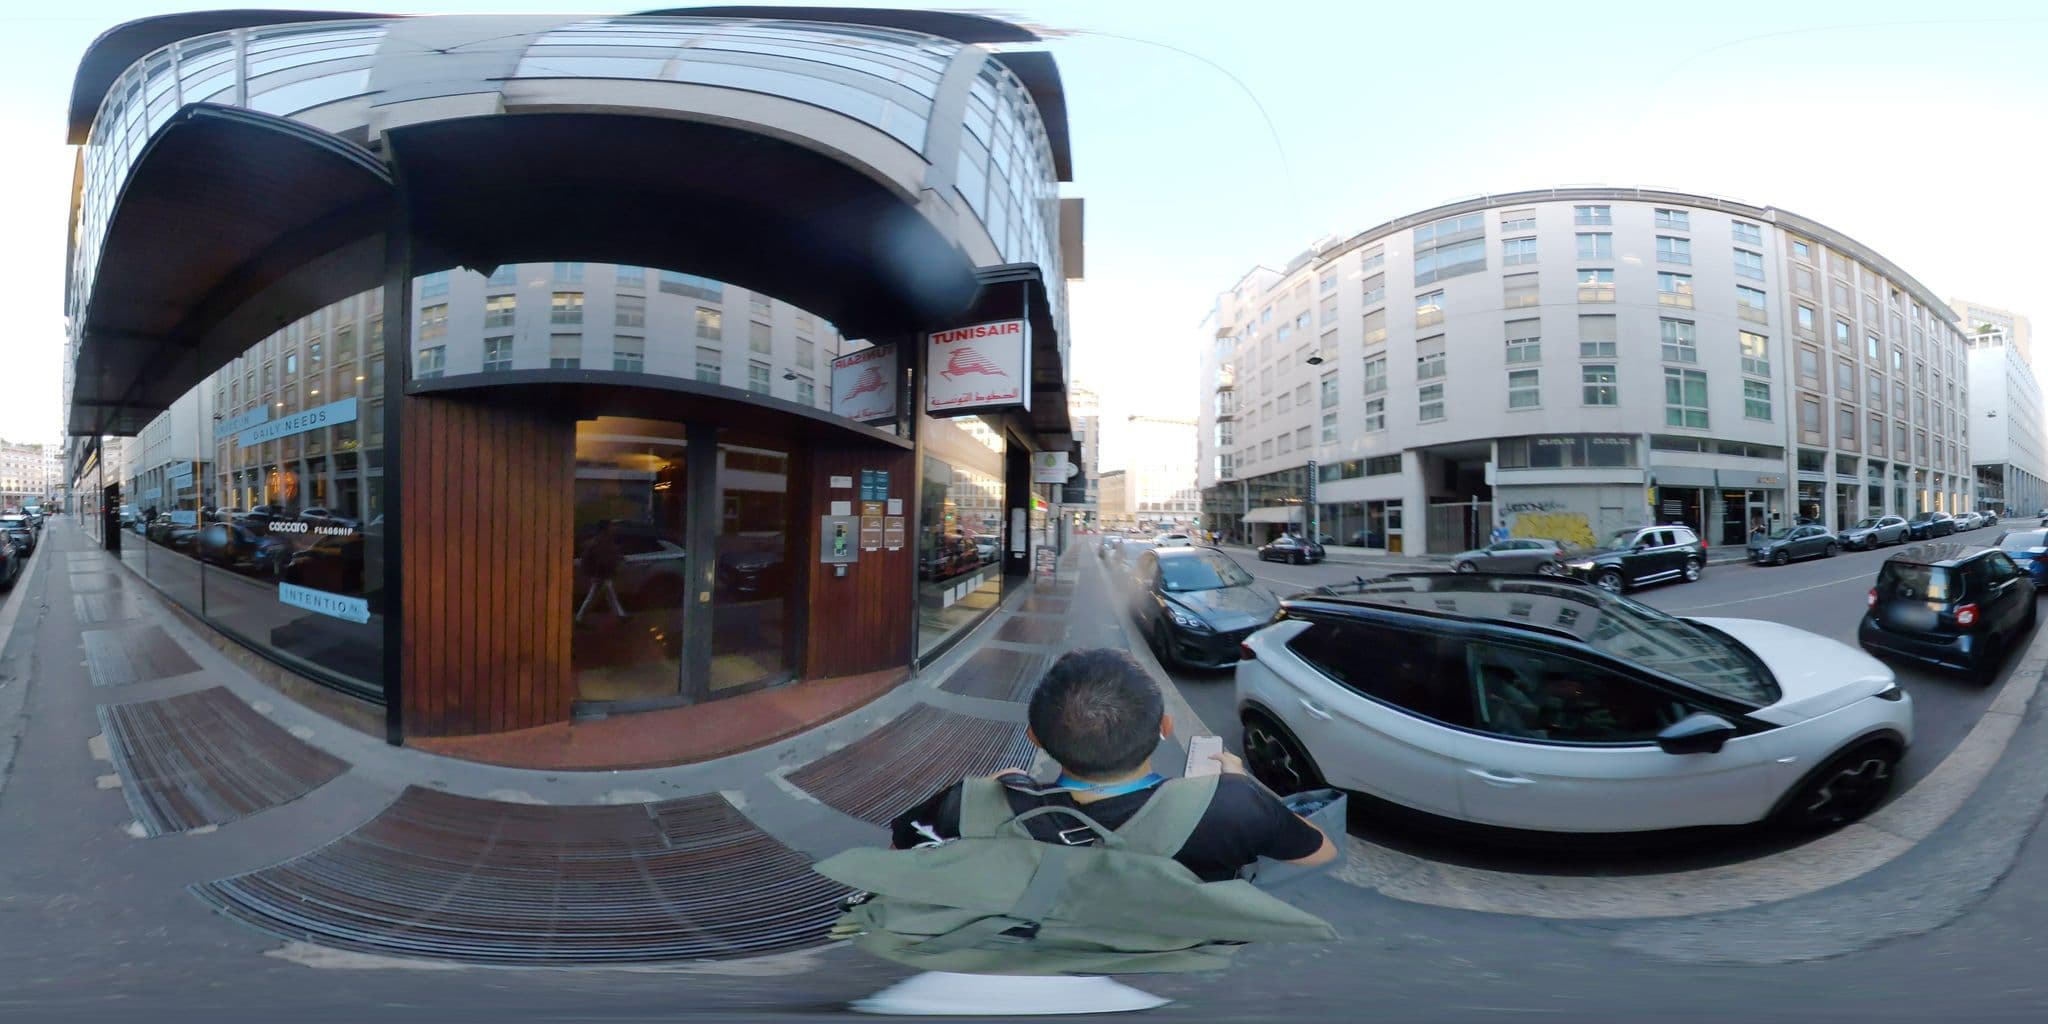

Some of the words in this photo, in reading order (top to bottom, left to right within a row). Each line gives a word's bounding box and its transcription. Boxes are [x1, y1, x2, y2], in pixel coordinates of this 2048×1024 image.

[931, 323, 1020, 345] TUNISAIR
[253, 424, 281, 441] DAILY
[285, 410, 326, 431] NEEDS
[268, 521, 308, 533] caccaro
[314, 526, 353, 536] FLAGSHIP
